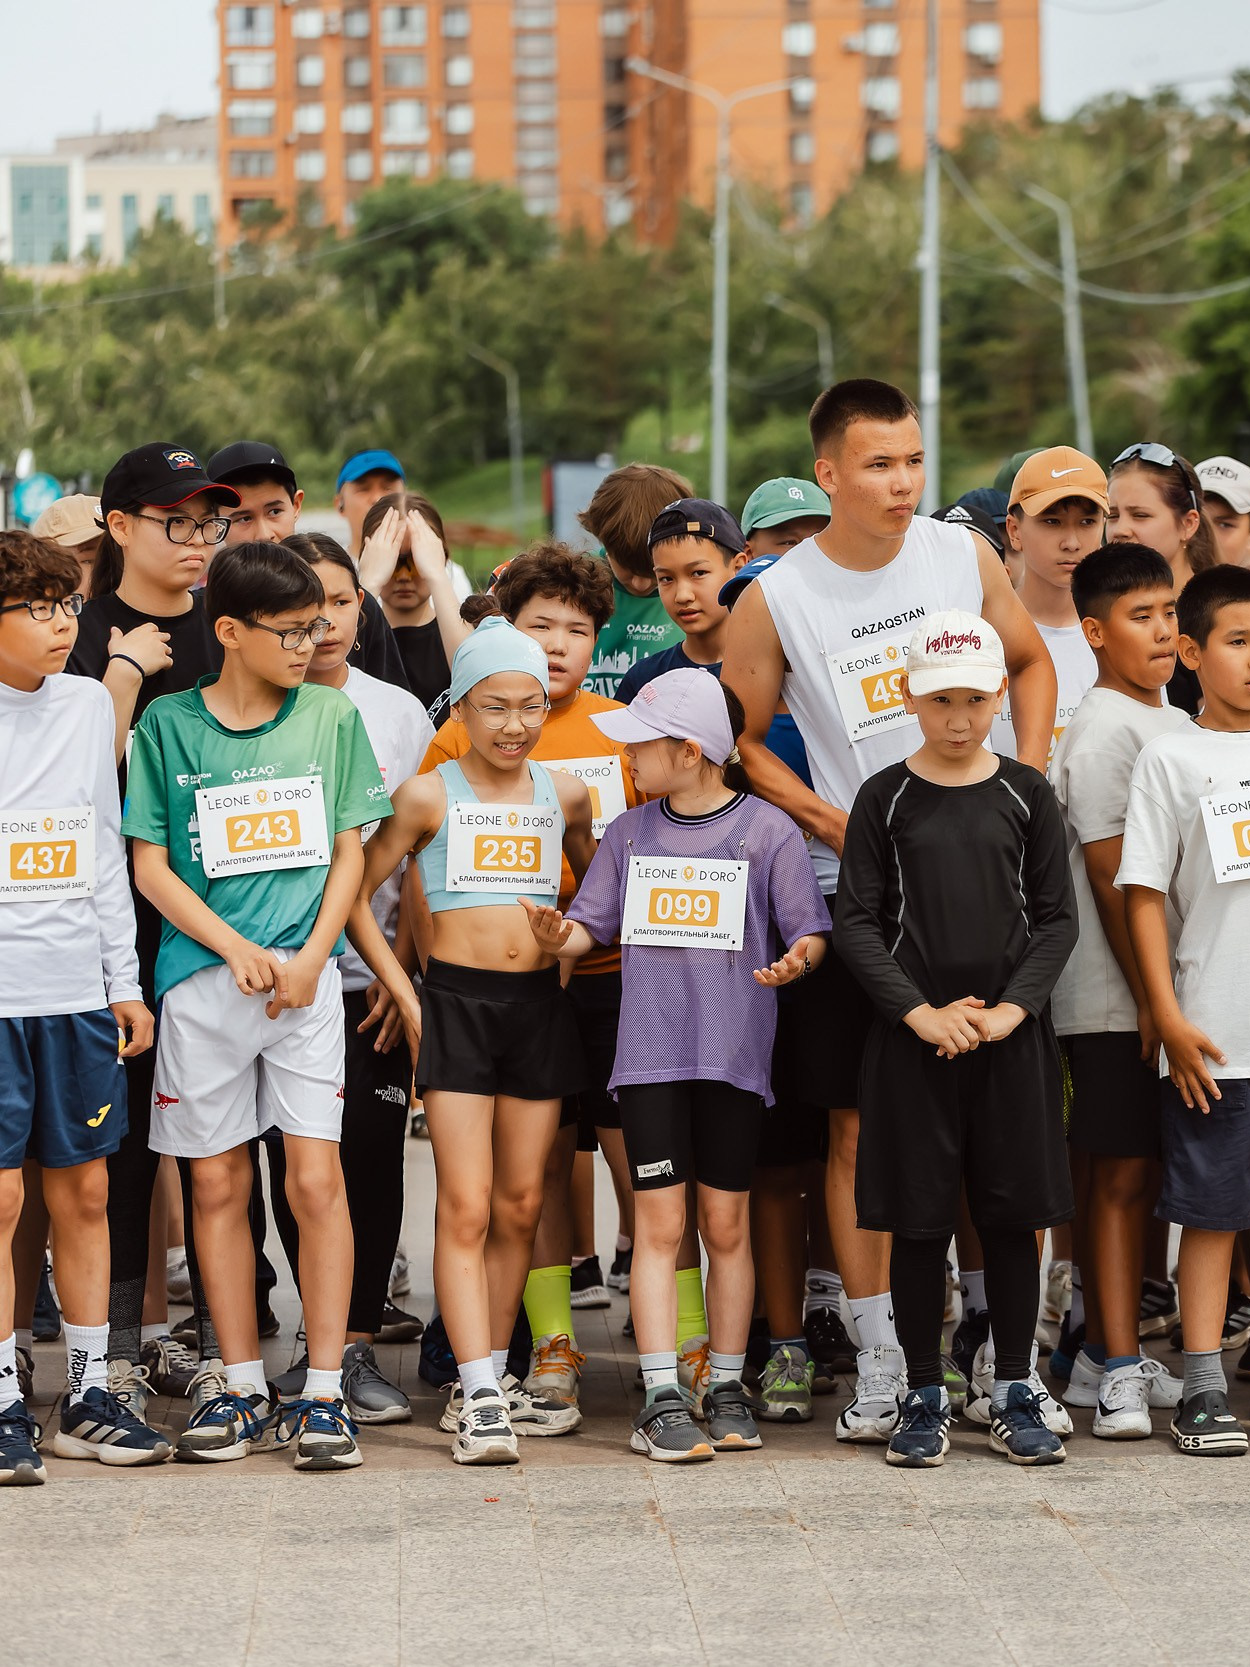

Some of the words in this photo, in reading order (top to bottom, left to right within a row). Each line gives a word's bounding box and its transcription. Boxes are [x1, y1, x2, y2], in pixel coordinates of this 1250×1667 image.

[1200, 466, 1239, 481] FENDI
[851, 607, 925, 638] QAZAQSTAN
[626, 633, 664, 642] marathon
[941, 630, 981, 650] Angeles
[840, 654, 882, 674] LEONE
[871, 673, 904, 704] 49
[858, 710, 908, 729] БЛАГОТВОРИТ
[208, 795, 251, 810] LEONE
[274, 788, 312, 801] D'ORO
[1, 822, 37, 833] EONE
[58, 819, 88, 831] D'ORO
[459, 814, 502, 825] LEONE
[523, 816, 553, 828] D'ORO
[234, 815, 293, 848] 243
[17, 845, 72, 875] 437
[216, 850, 295, 867] БЛАГОТВОРИТЕЛЬНЫЙ
[296, 849, 317, 857] ЗАБЕГ
[480, 839, 536, 868] 235
[459, 875, 534, 884] БЛАГОТВОРИТЕЛЬНЫЙ
[638, 868, 678, 879] LEONE
[699, 870, 737, 882] D'ORO
[0, 882, 71, 893] ЛАГОТВОРИТЕЛЬНЫЙ
[71, 881, 87, 889] ЗАБЕГ
[656, 893, 711, 922] 099
[633, 928, 709, 938] БЛАГОТВОРИТЕЛЬНЫЙ
[710, 931, 731, 940] ЗАБЕГ
[374, 1089, 399, 1098] NORTH
